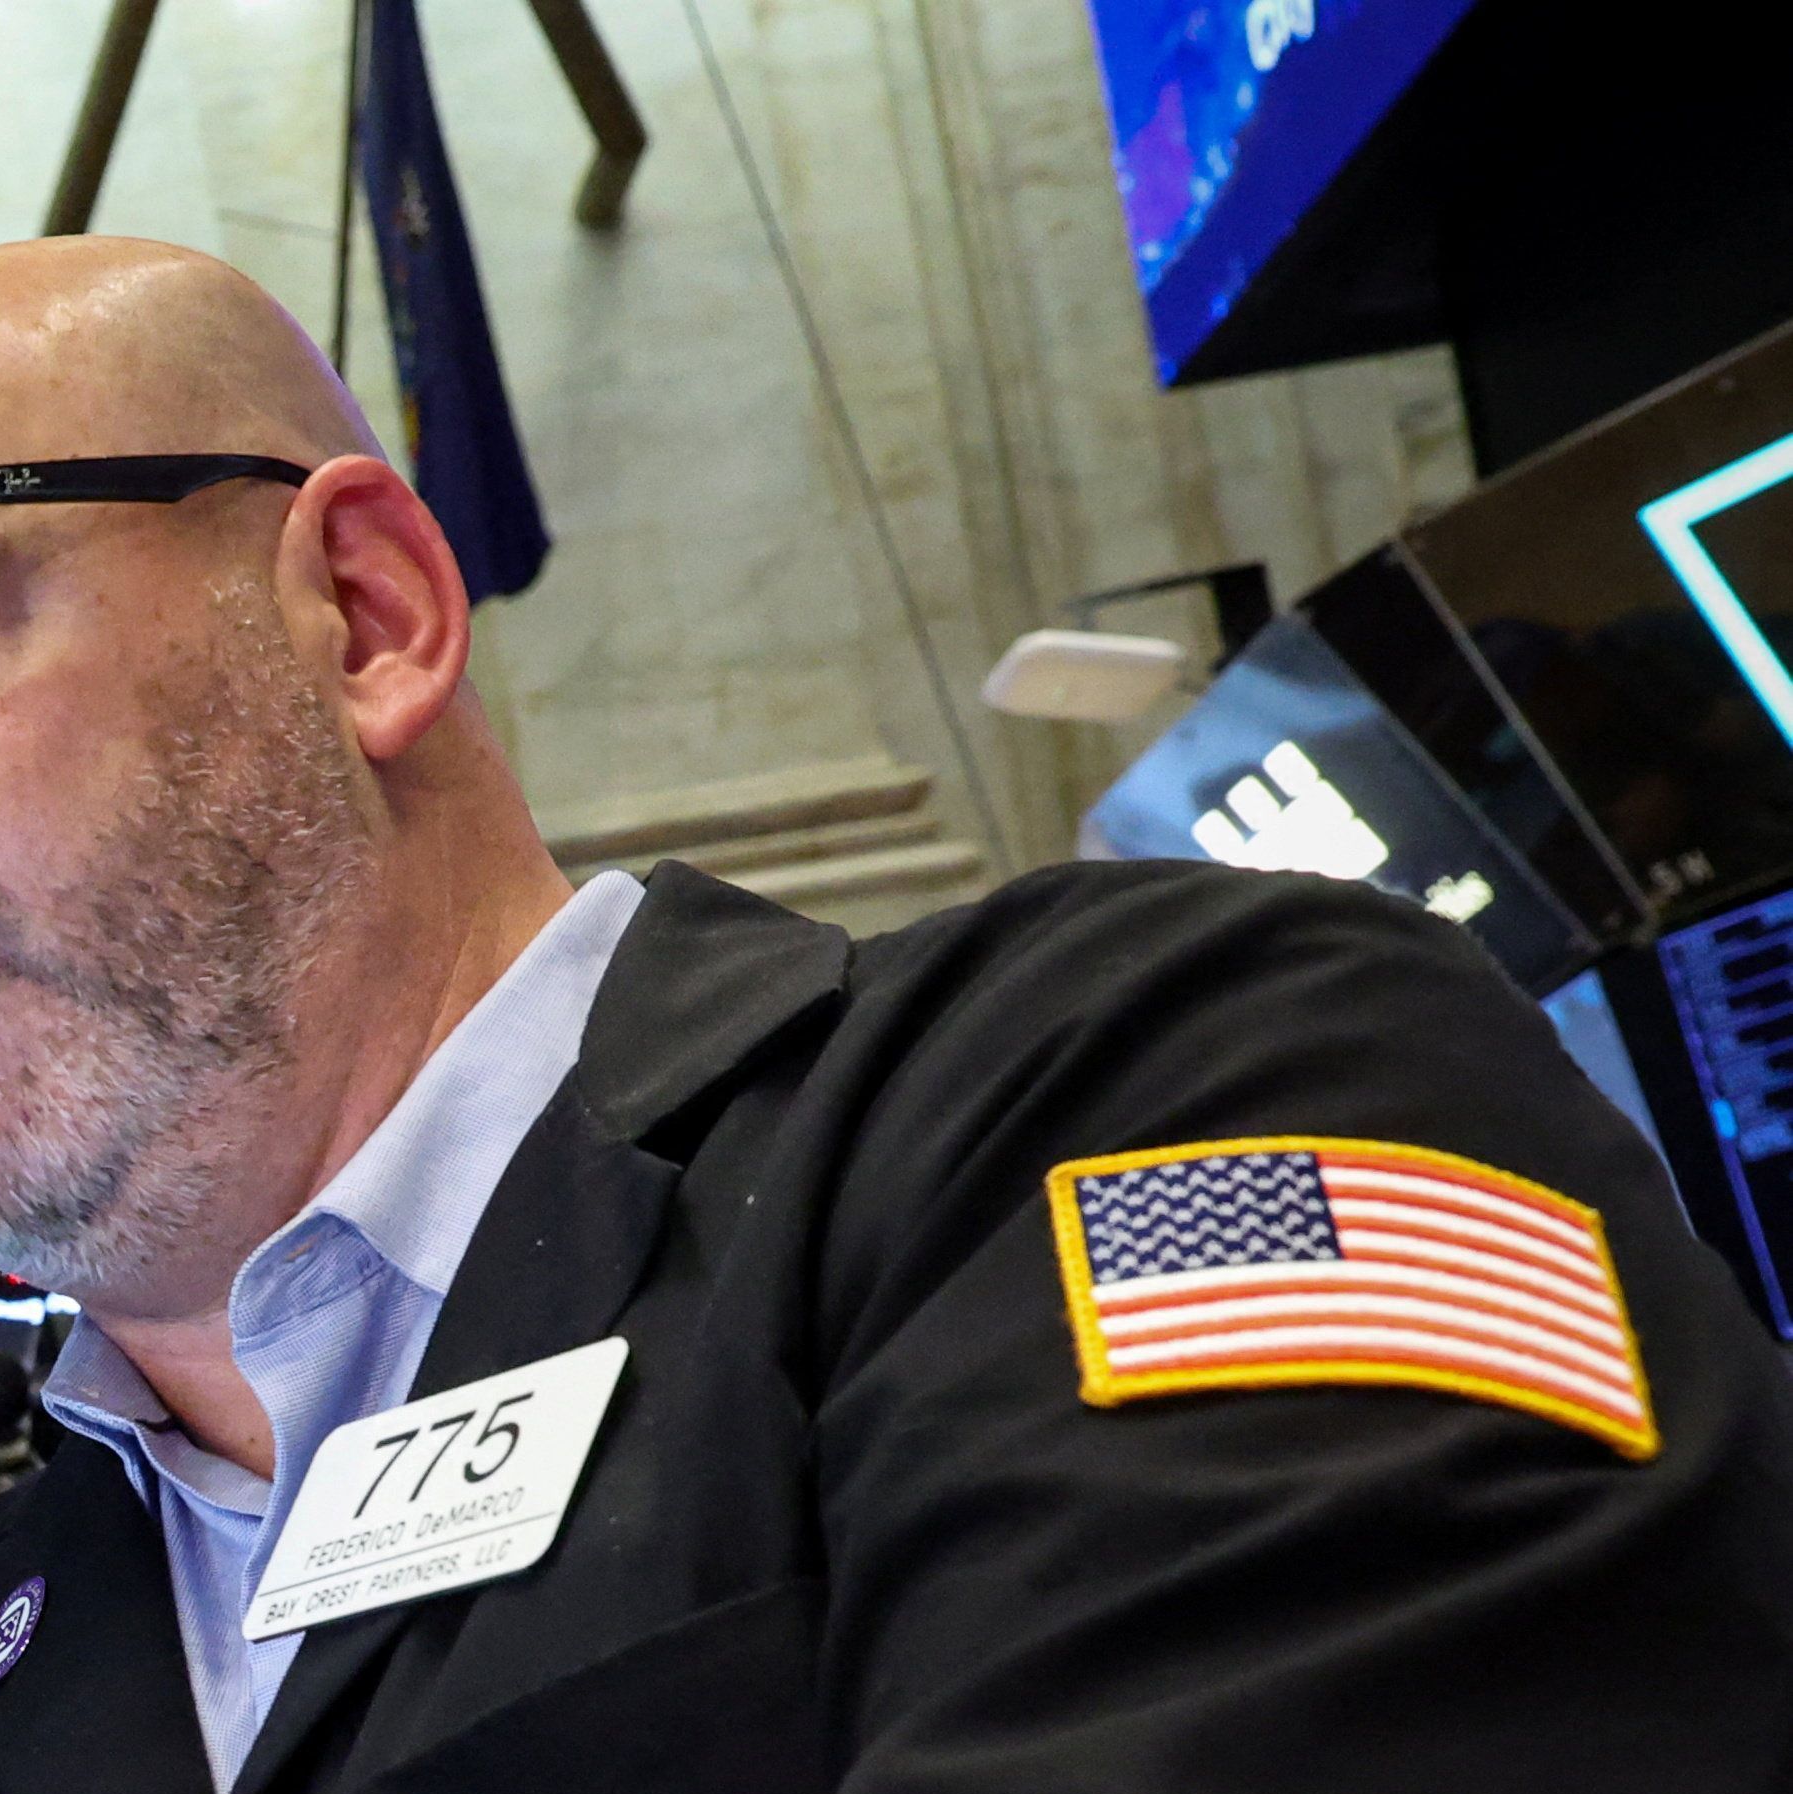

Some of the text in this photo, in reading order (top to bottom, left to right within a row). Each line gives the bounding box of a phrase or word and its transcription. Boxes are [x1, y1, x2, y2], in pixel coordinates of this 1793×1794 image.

[353, 1391, 534, 1519] 775
[304, 1487, 525, 1570] FEDERICO DeMARCO
[264, 1598, 300, 1625] BAY
[305, 1580, 361, 1614] CREST
